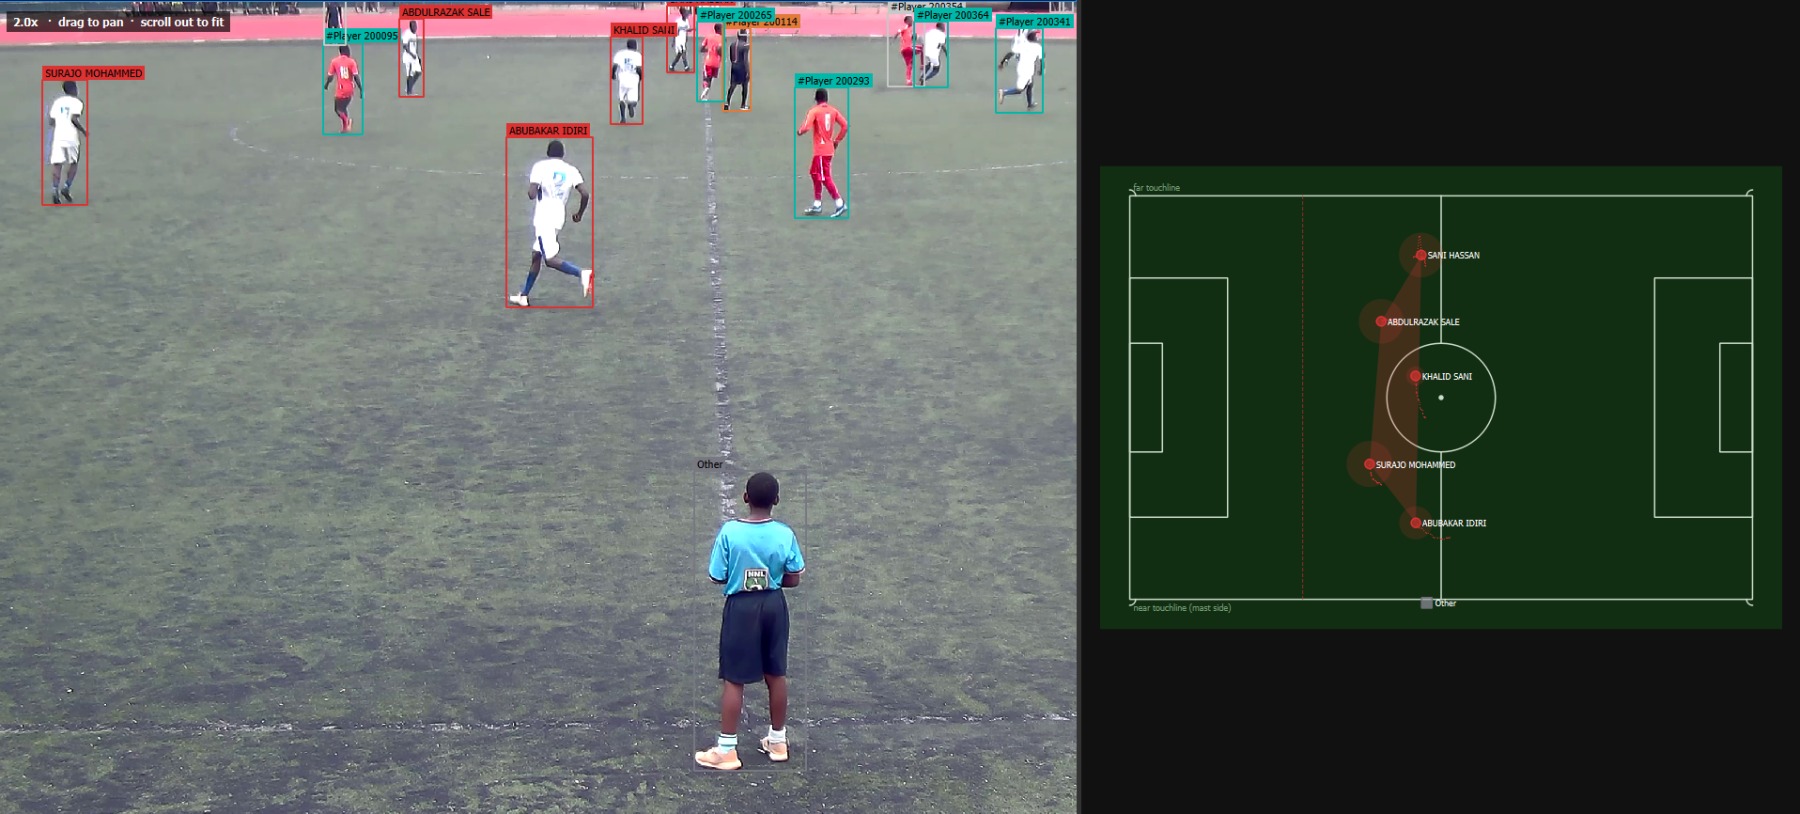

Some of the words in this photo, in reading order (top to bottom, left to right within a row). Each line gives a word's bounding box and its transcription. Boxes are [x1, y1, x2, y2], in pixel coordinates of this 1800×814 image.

[1133, 182, 1144, 191] far
[1146, 182, 1180, 192] touchline
[1427, 251, 1447, 259] SANI
[1448, 251, 1480, 259] HASSAN
[1387, 318, 1439, 326] ABDULRAZAK
[1441, 318, 1460, 326] SALE
[1422, 372, 1451, 380] KHALID
[1453, 372, 1472, 380] SANI
[1375, 461, 1407, 469] SURAJO
[1408, 461, 1456, 469] MOHAMMED
[1421, 519, 1464, 527] ABUBAKAR
[1466, 519, 1487, 527] IDIRI
[1434, 599, 1457, 607] Other
[1133, 604, 1151, 612] near
[1152, 603, 1187, 612] touchline
[1189, 603, 1211, 613] (mast
[1213, 603, 1232, 613] side)
